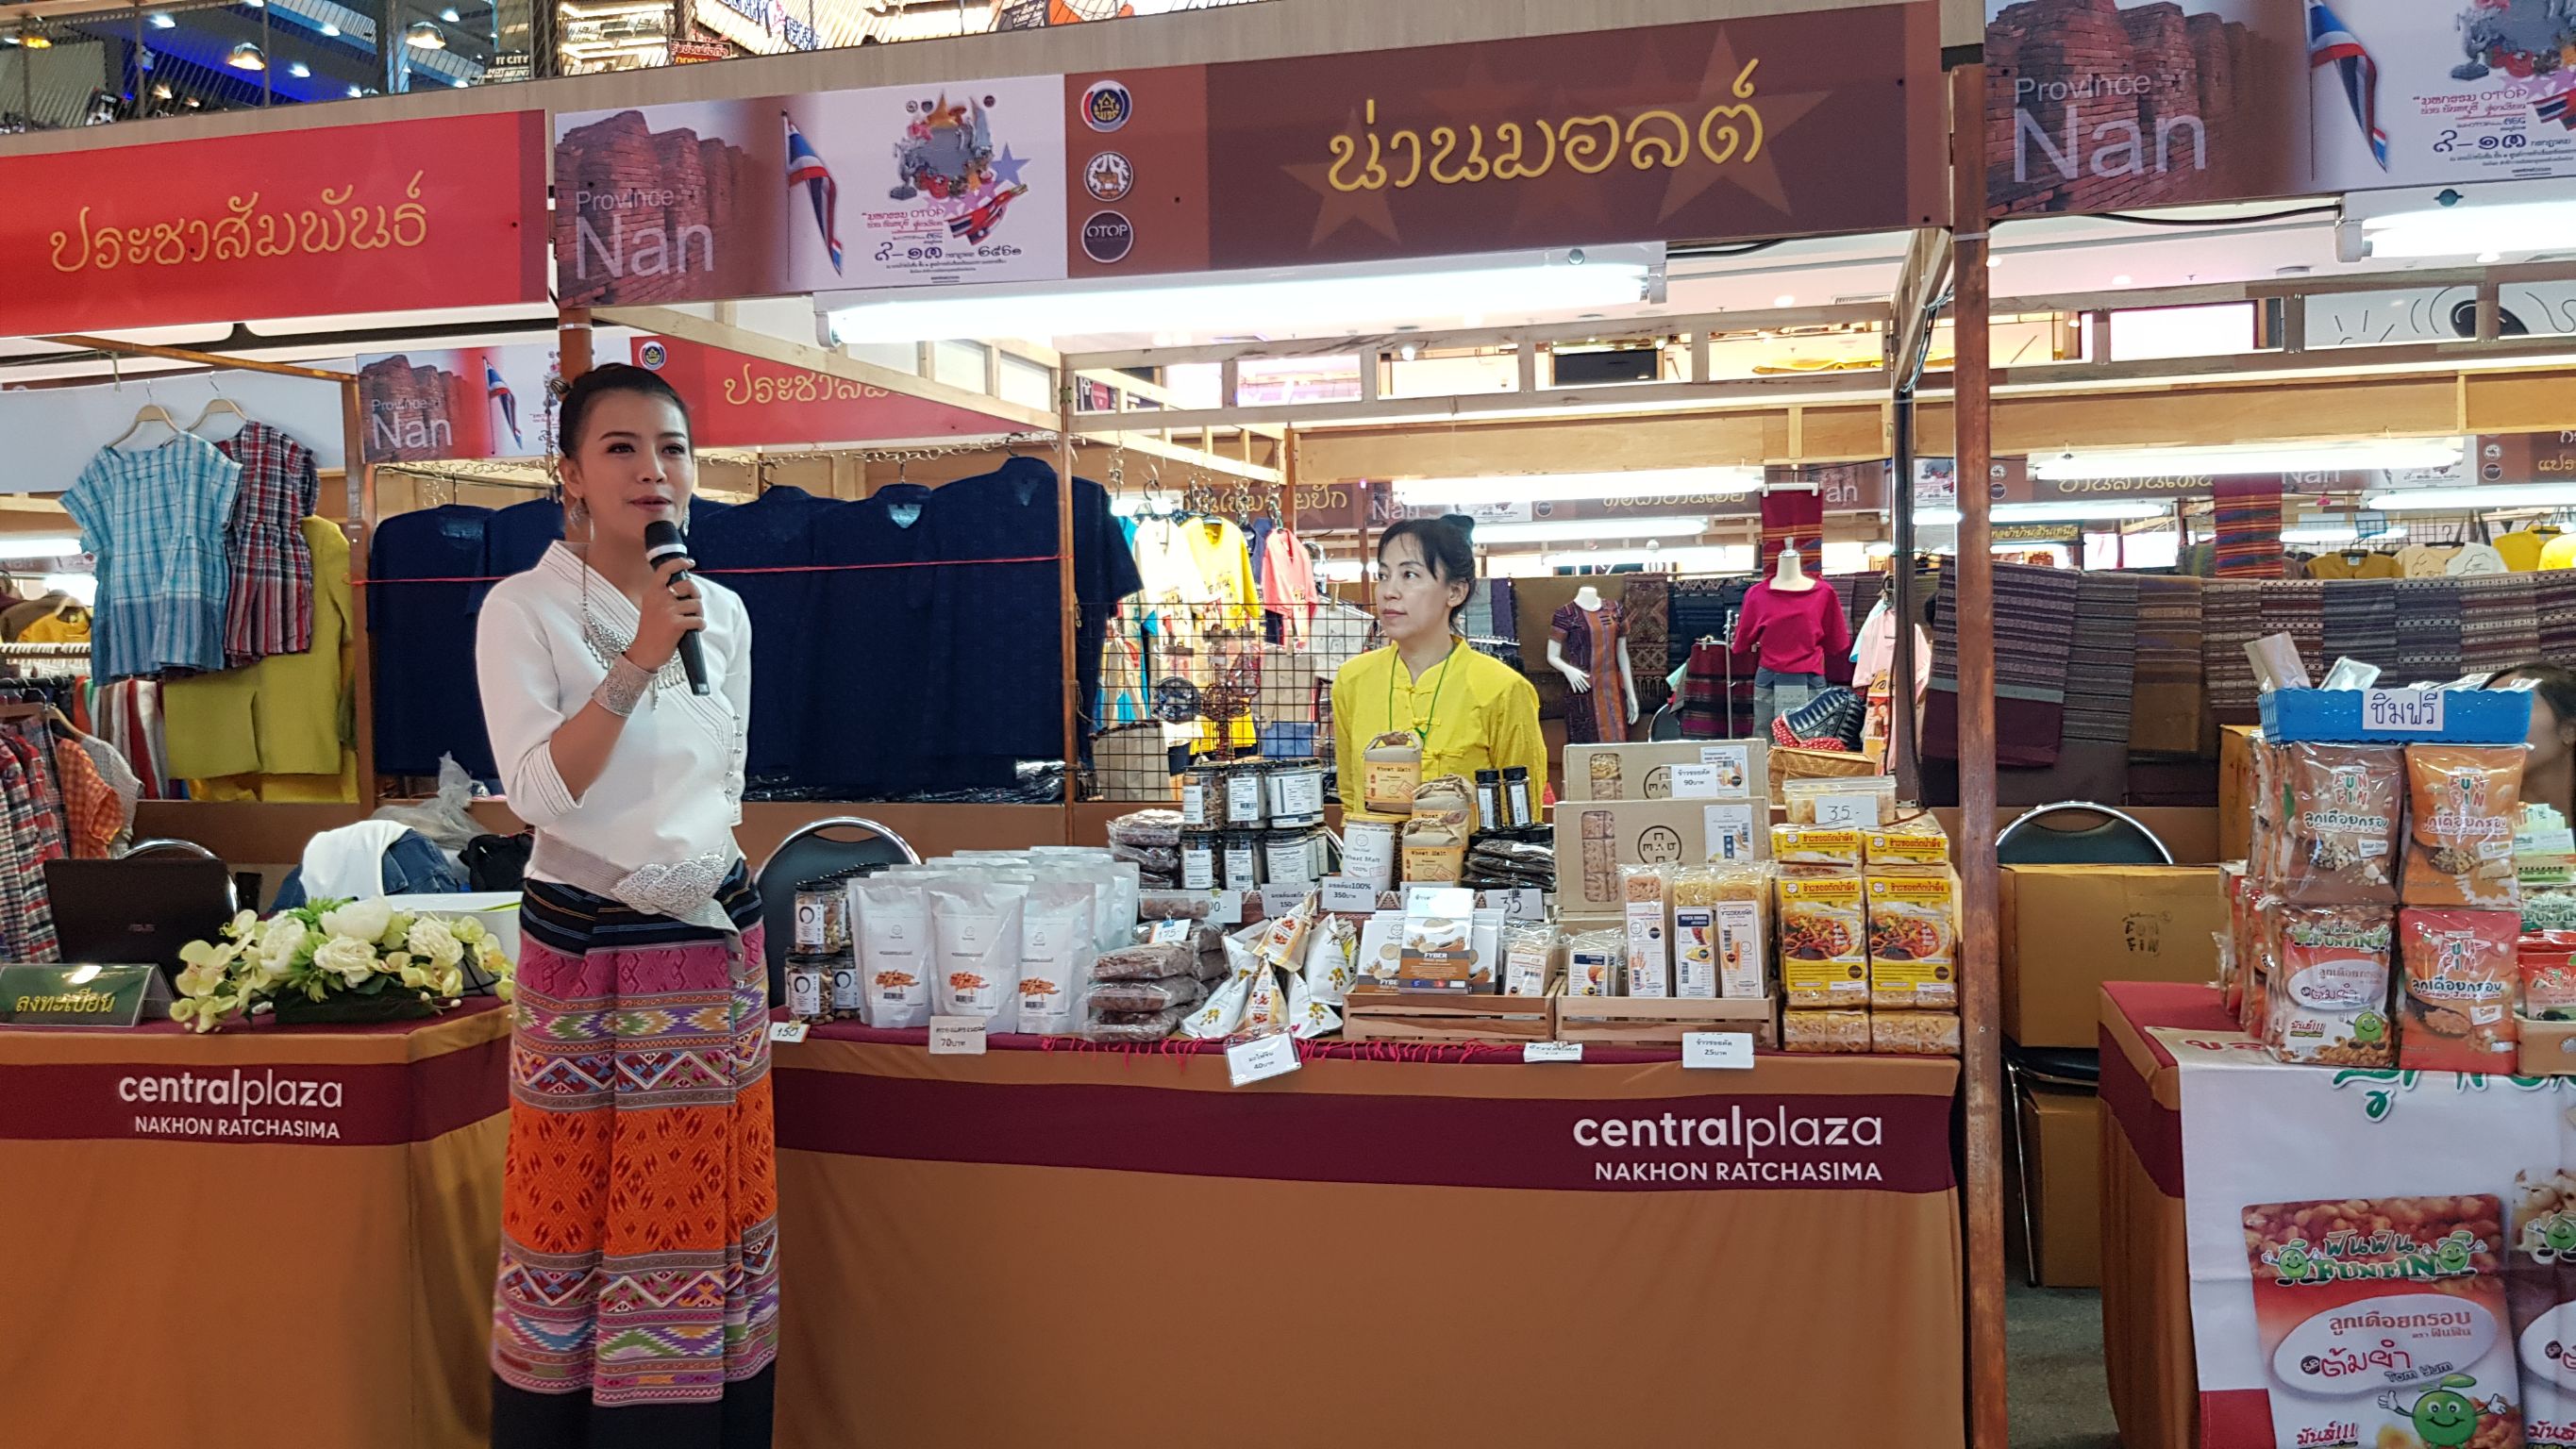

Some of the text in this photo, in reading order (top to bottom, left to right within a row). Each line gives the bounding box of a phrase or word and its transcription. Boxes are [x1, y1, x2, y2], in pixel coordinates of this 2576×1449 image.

[495, 55, 529, 65] IT CITY
[2015, 71, 2151, 103] Province
[2481, 90, 2528, 101] OTOP
[1328, 58, 1765, 192] น่านมอลต์
[2014, 106, 2206, 183] Nan
[576, 187, 675, 213] Province
[50, 170, 427, 273] ประชาสัมพันธ์
[911, 208, 944, 218] OTOP
[1086, 225, 1129, 238] OTOP
[576, 213, 714, 281] Nan
[372, 398, 427, 411] Province
[372, 410, 453, 450] Nan
[2370, 691, 2438, 725] ชิมฟรี
[2333, 773, 2369, 790] FUN
[2449, 775, 2485, 791] FUN
[2334, 790, 2369, 806] FIN
[2127, 937, 2160, 953] FIN
[15, 988, 116, 1013] ลงทะเบียน
[119, 1068, 343, 1116] centralplaza
[135, 1116, 341, 1139] NAKHON RATCHASIMA
[1573, 1105, 1882, 1159] centralplaza
[1595, 1161, 1882, 1182] NAKHON RATCHASIMA
[2324, 1229, 2417, 1258] ฟินฟิน
[2312, 1256, 2438, 1281] FUNFIN
[2329, 1310, 2471, 1337] ลูกเดือยกรอบ
[2321, 1339, 2412, 1377] ต้มยำ
[2384, 1361, 2454, 1384] Tom Yum
[2296, 1421, 2358, 1446] มันส์!!!
